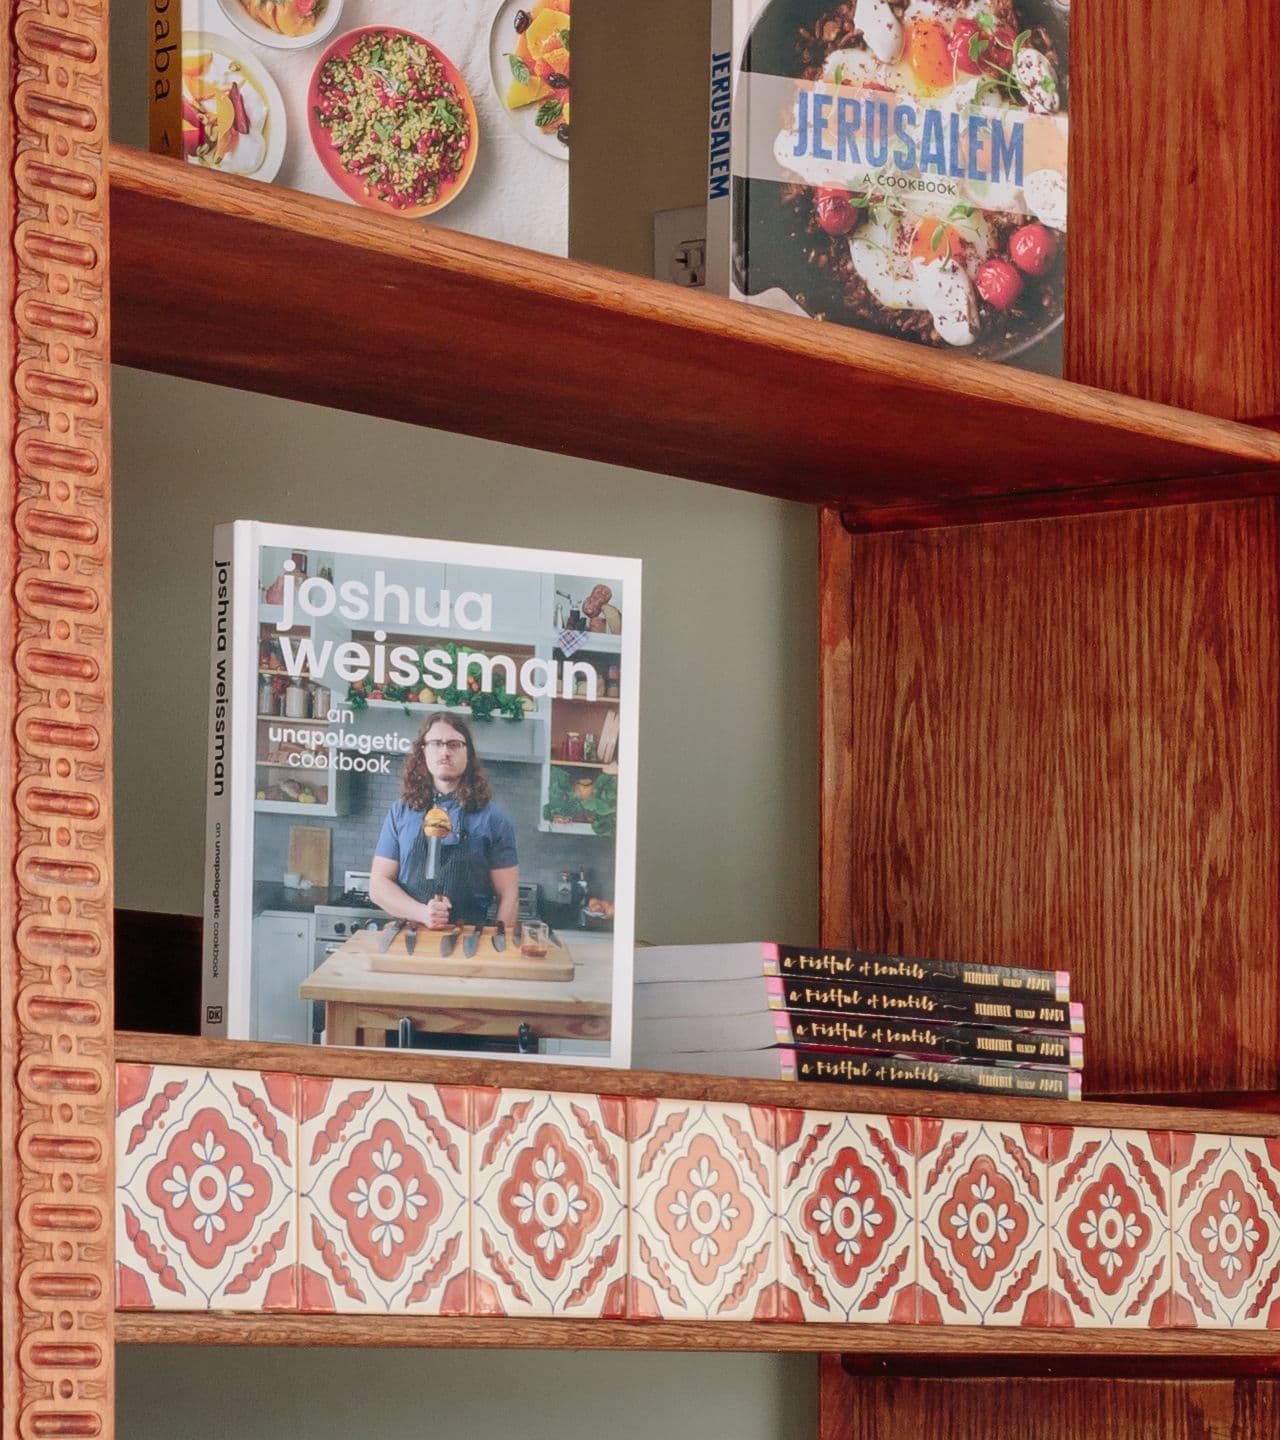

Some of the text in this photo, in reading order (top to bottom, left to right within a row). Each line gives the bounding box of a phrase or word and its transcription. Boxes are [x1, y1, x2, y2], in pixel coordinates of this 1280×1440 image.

[708, 51, 732, 201] JERUSALEM
[793, 91, 1025, 187] JERUSALEM
[863, 173, 956, 196] A COOKBOOK
[276, 559, 493, 632] joshua
[214, 560, 231, 797] joshua weissman
[278, 630, 598, 702] weissman
[327, 706, 354, 724] an
[269, 725, 412, 755] unapologetic
[288, 752, 391, 774] cookbook
[212, 822, 222, 979] an unapologetic cookbook
[800, 955, 855, 975] Fistful
[805, 988, 862, 1008] Fistful
[208, 1009, 221, 1020] DK
[812, 1023, 868, 1041] Fistful
